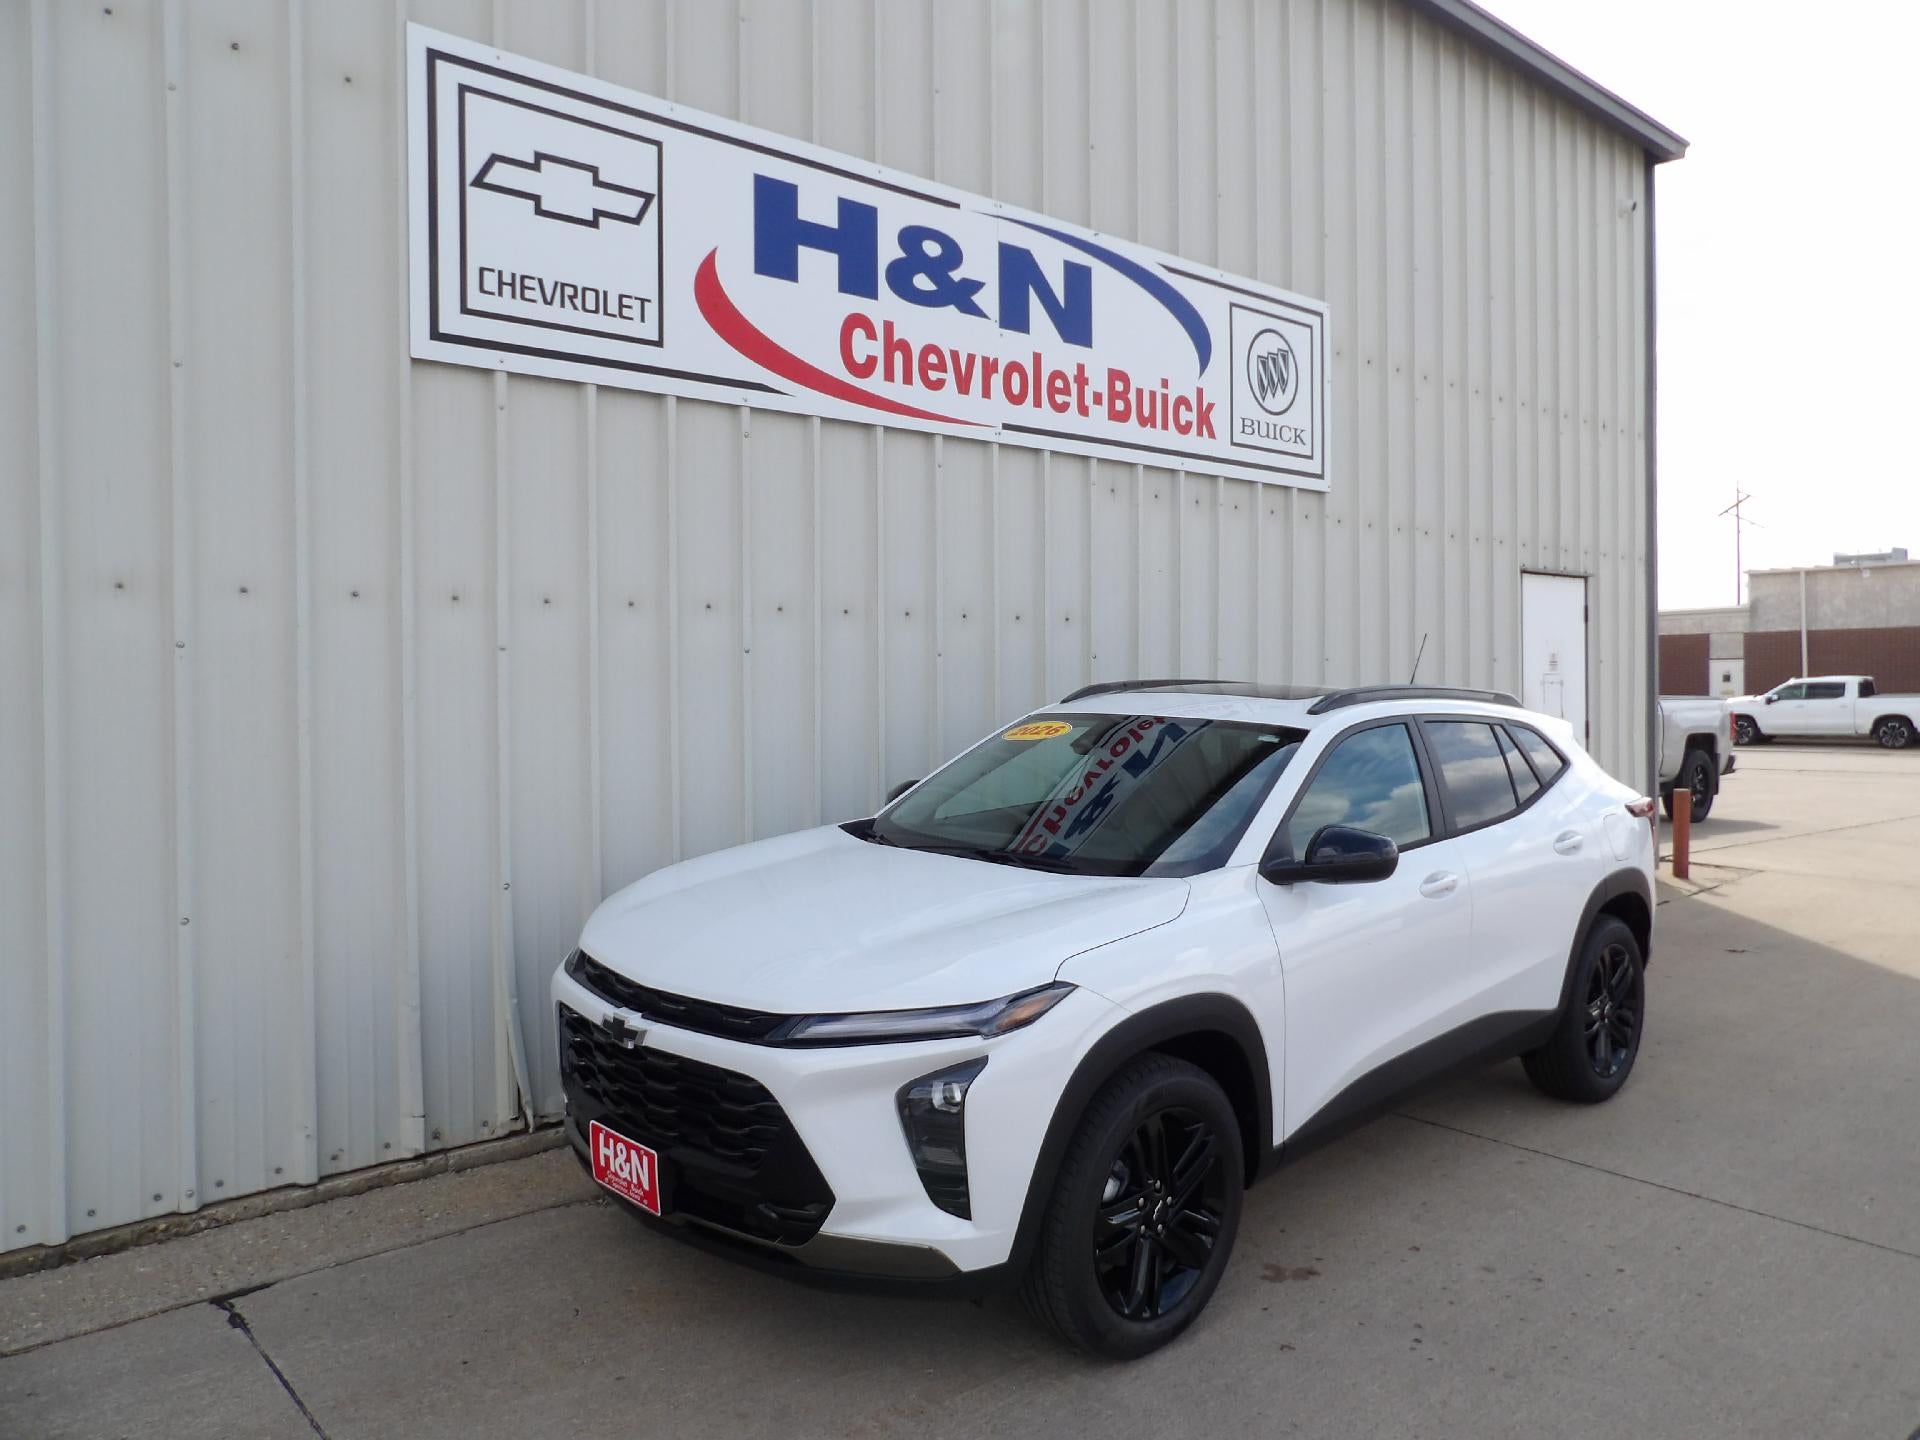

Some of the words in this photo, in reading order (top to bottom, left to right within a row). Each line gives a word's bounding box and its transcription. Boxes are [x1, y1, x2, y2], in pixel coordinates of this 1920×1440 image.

[753, 173, 1093, 349] H&N
[478, 266, 652, 324] CHEVROLET
[839, 312, 1217, 441] Chevrolet-Buick
[1240, 416, 1306, 446] BUICK
[1006, 724, 1067, 737] 2026
[599, 1132, 650, 1191] H&N
